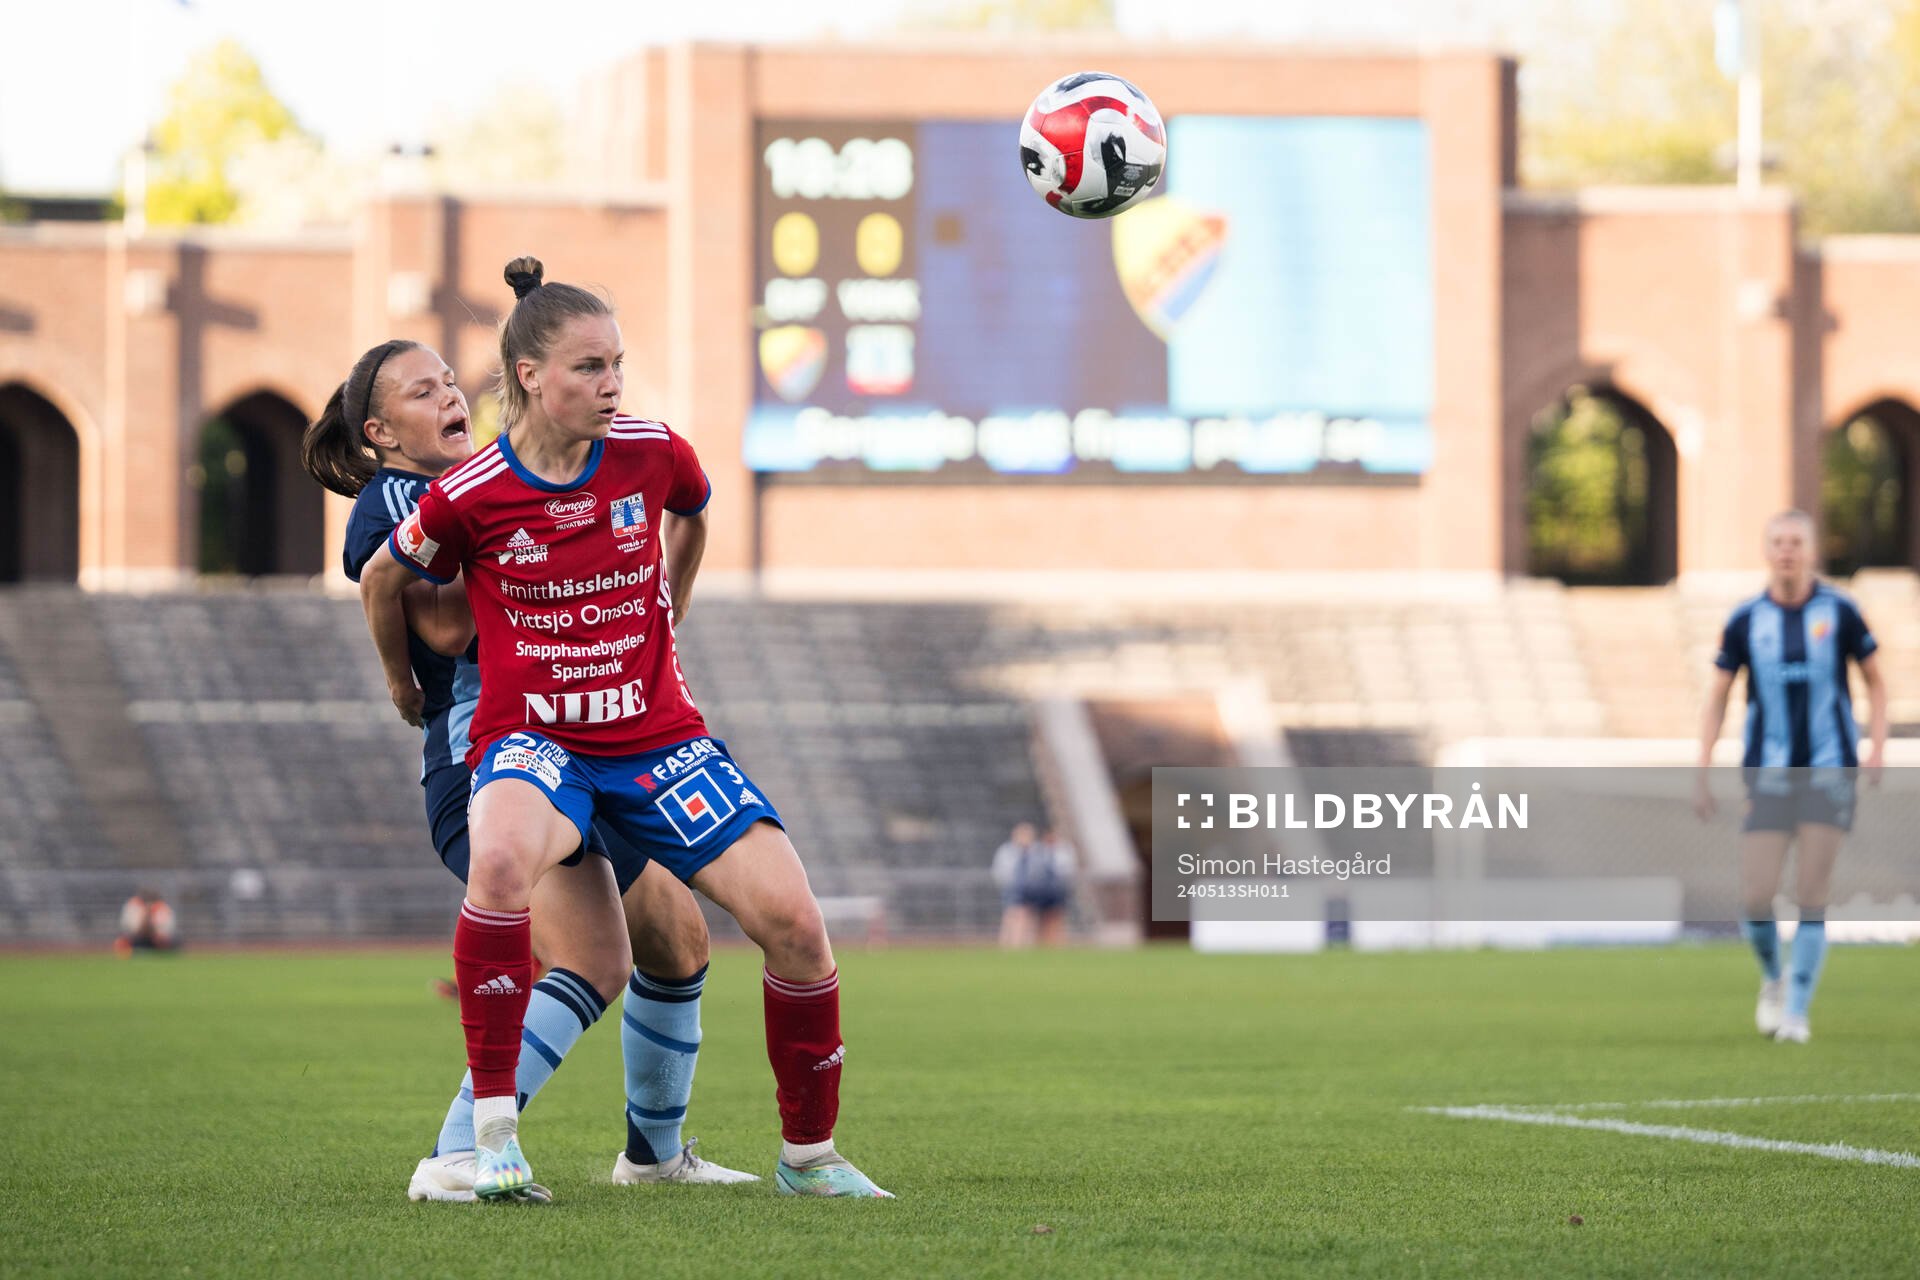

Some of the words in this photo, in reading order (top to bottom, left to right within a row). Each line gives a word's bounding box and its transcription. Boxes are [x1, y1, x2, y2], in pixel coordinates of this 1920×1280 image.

[547, 497, 594, 515] Carnegie
[556, 517, 596, 531] PRIVATBANK
[507, 539, 534, 547] adidas
[514, 545, 548, 555] INTER
[516, 552, 548, 564] SPORT
[501, 564, 654, 599] #mitthässleholm
[505, 608, 573, 634] Vittsjö
[580, 597, 646, 625] Omsorg
[552, 658, 623, 682] Sparbank
[522, 678, 648, 724] NIBE
[652, 739, 719, 780] FASAB
[719, 762, 744, 785] 3
